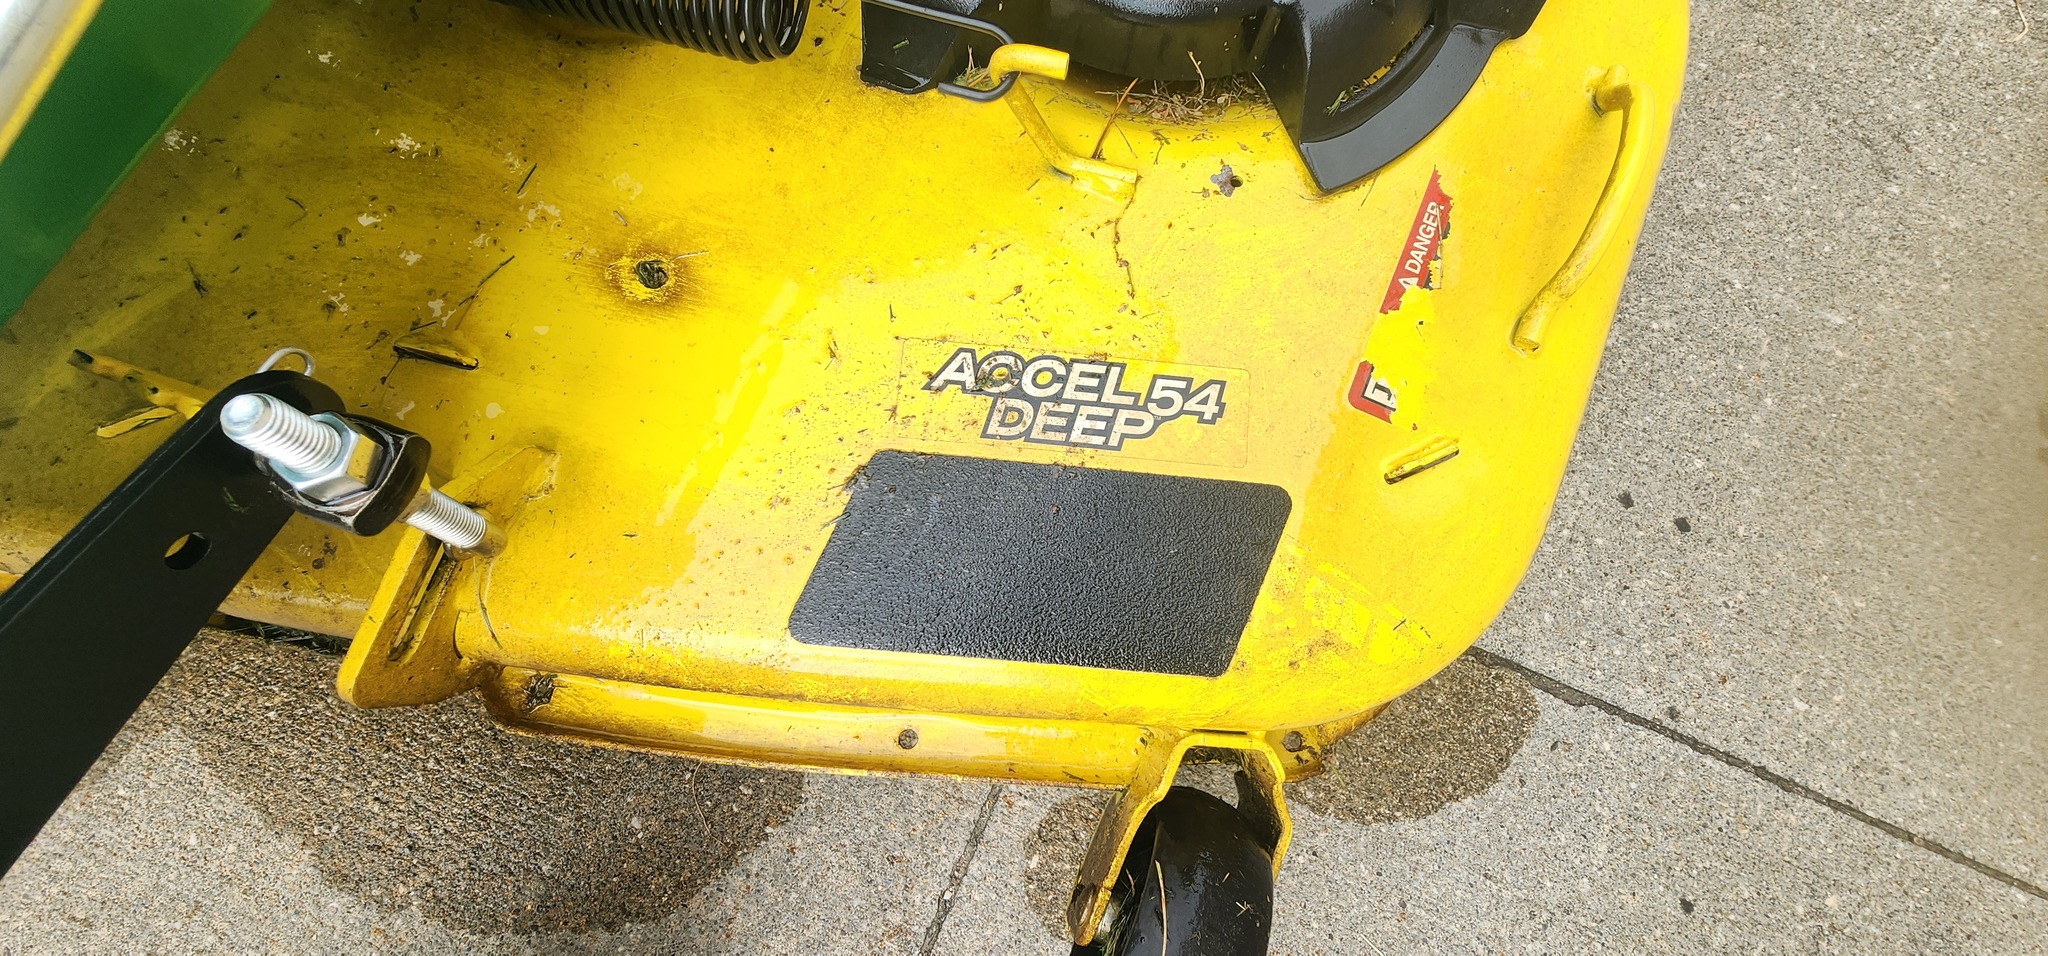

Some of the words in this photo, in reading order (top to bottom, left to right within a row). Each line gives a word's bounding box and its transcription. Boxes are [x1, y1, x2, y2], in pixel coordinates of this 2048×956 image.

[1404, 201, 1445, 275] DANGER
[925, 348, 1138, 407] ACCEL
[1144, 375, 1225, 424] 54
[983, 397, 1156, 449] DEEP
